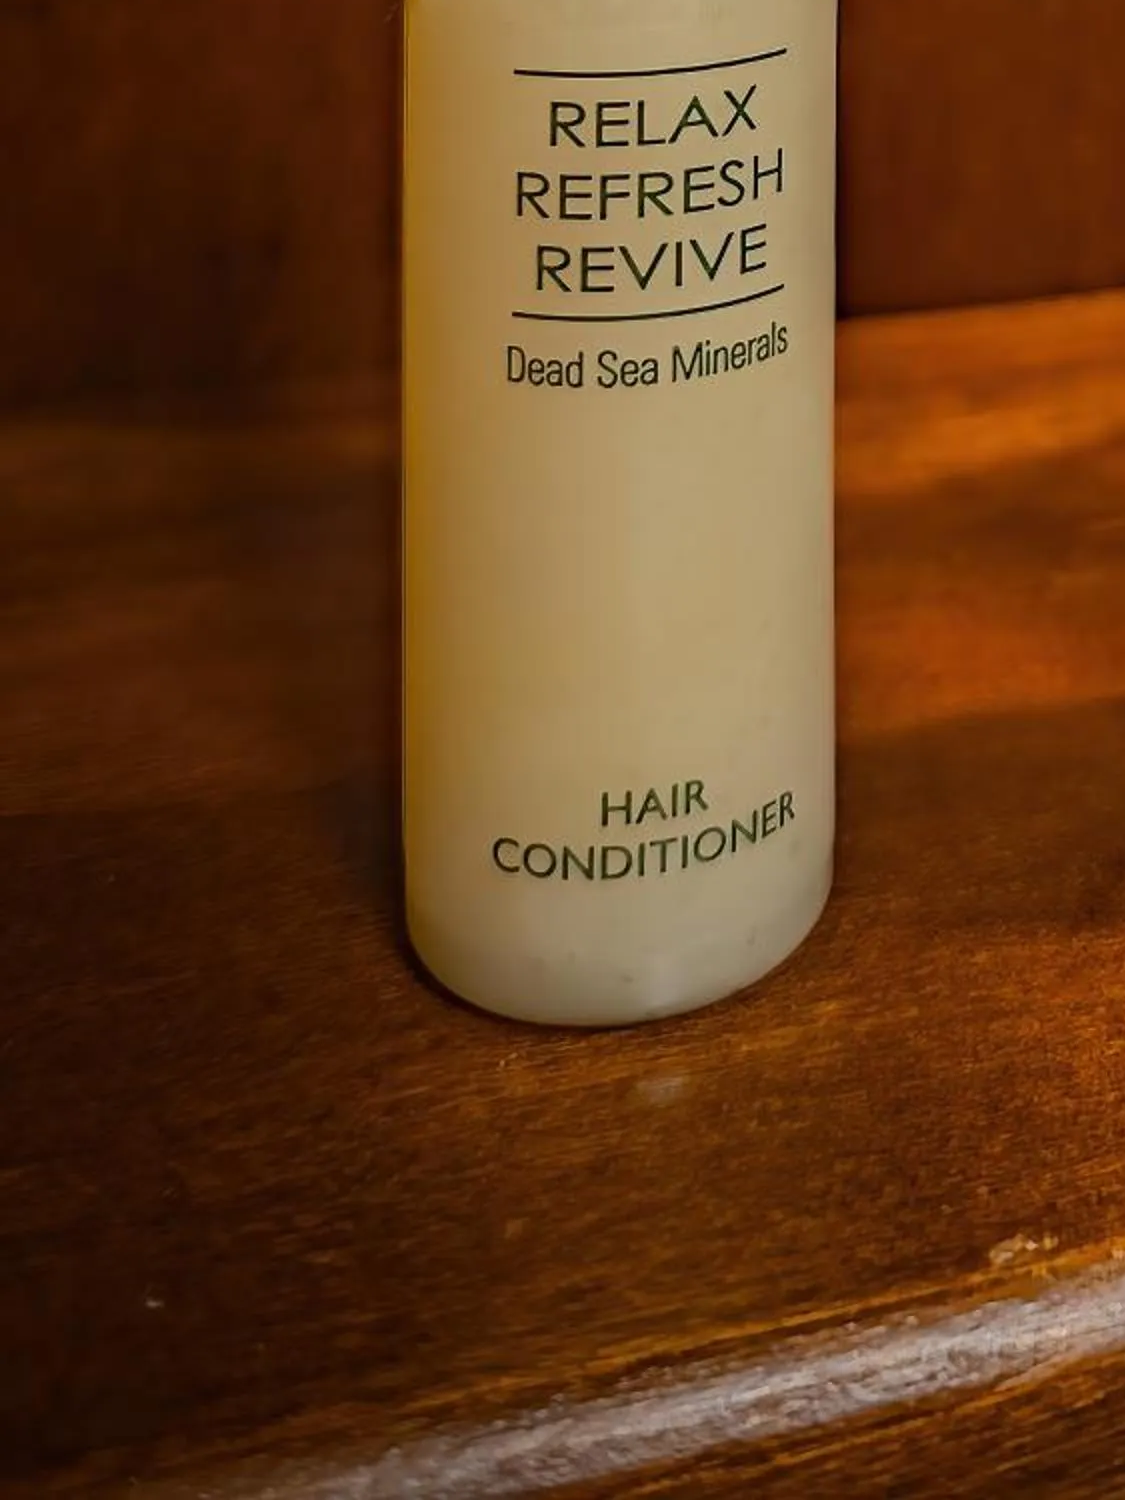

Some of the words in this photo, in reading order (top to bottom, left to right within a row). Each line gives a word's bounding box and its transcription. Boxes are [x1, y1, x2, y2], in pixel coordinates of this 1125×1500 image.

[548, 83, 758, 149] RELAX
[515, 147, 784, 221] REFRESH
[535, 223, 768, 293] REVIVE
[506, 344, 584, 388] Dead
[596, 349, 660, 389] Sea
[671, 320, 789, 384] Minerals
[491, 790, 796, 881] CONDITIONER
[600, 779, 709, 828] HAIR
